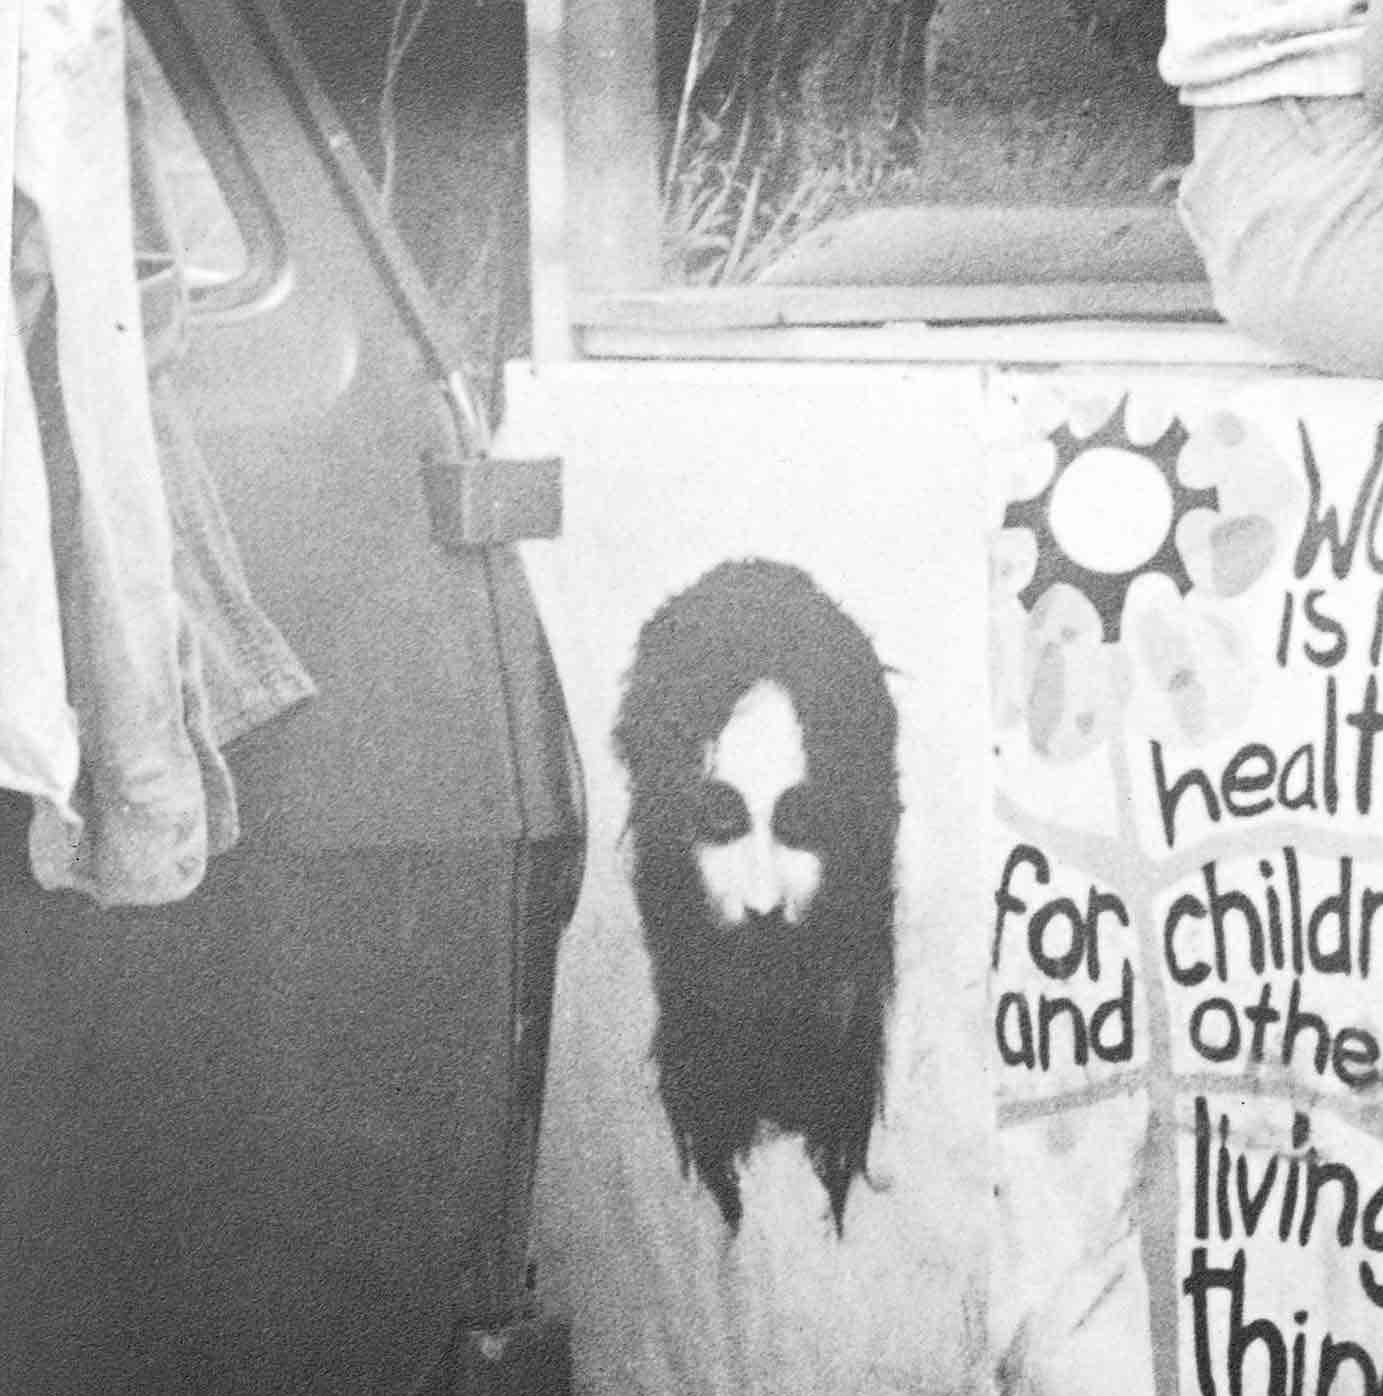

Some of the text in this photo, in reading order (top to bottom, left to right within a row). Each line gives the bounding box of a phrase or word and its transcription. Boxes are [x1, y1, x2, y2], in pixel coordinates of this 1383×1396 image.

[1275, 588, 1348, 668] is
[990, 842, 1131, 983] for
[994, 957, 1135, 1073] and
